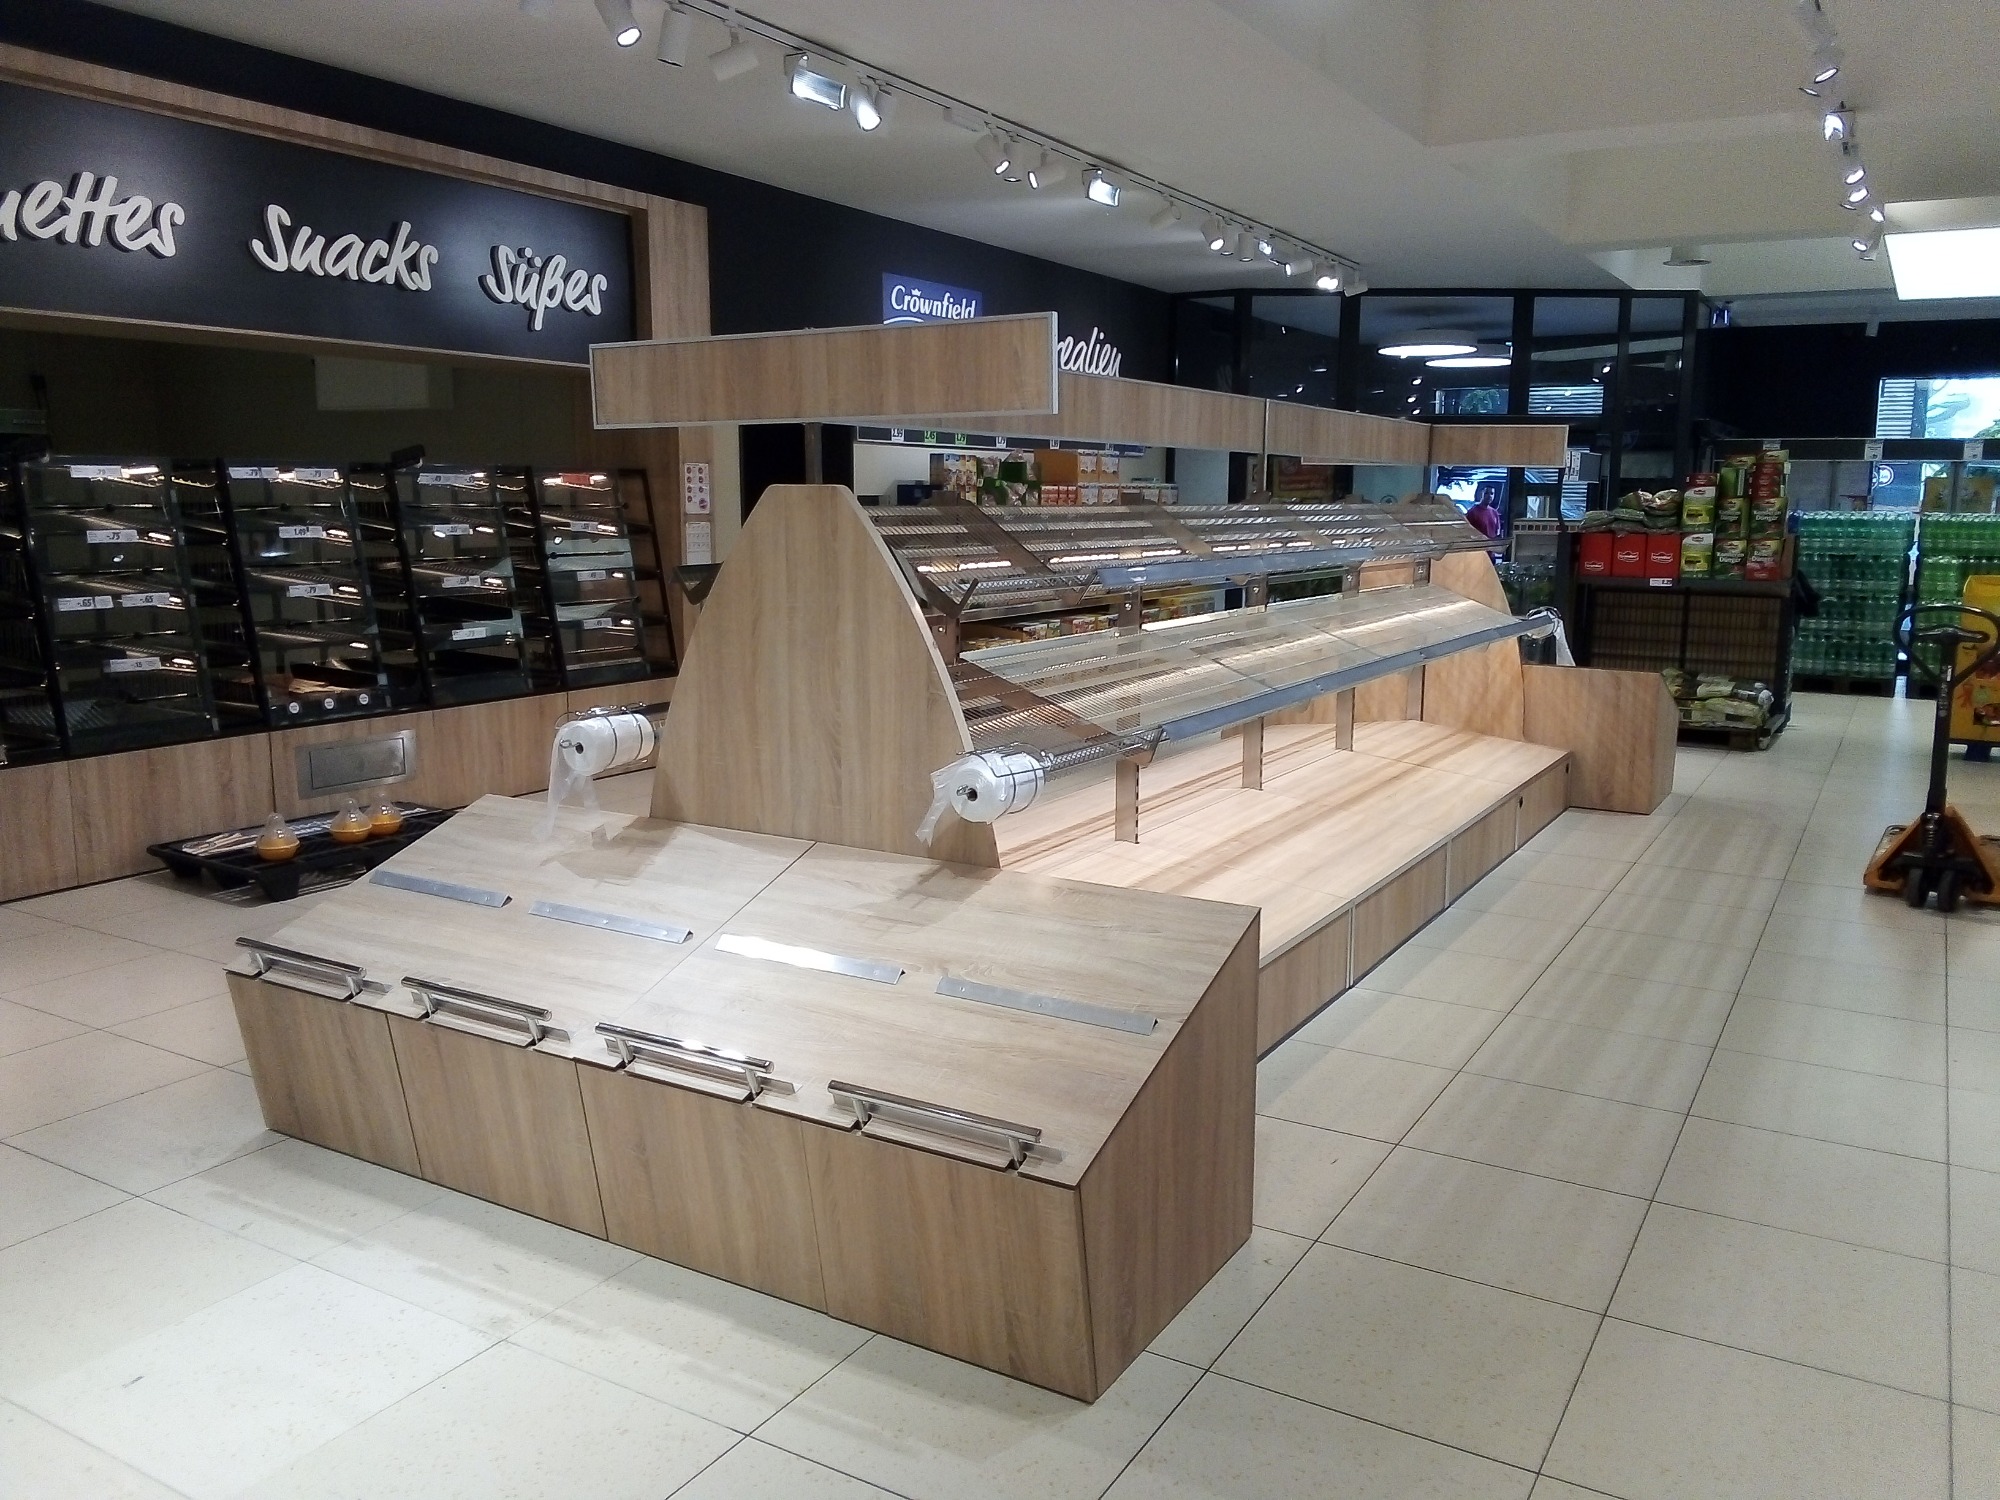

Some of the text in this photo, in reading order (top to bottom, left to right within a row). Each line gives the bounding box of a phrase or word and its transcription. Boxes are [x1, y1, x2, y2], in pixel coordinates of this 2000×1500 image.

[250, 203, 439, 291] Snacks
[480, 244, 608, 331] Süßes
[890, 284, 977, 320] Crownfield
